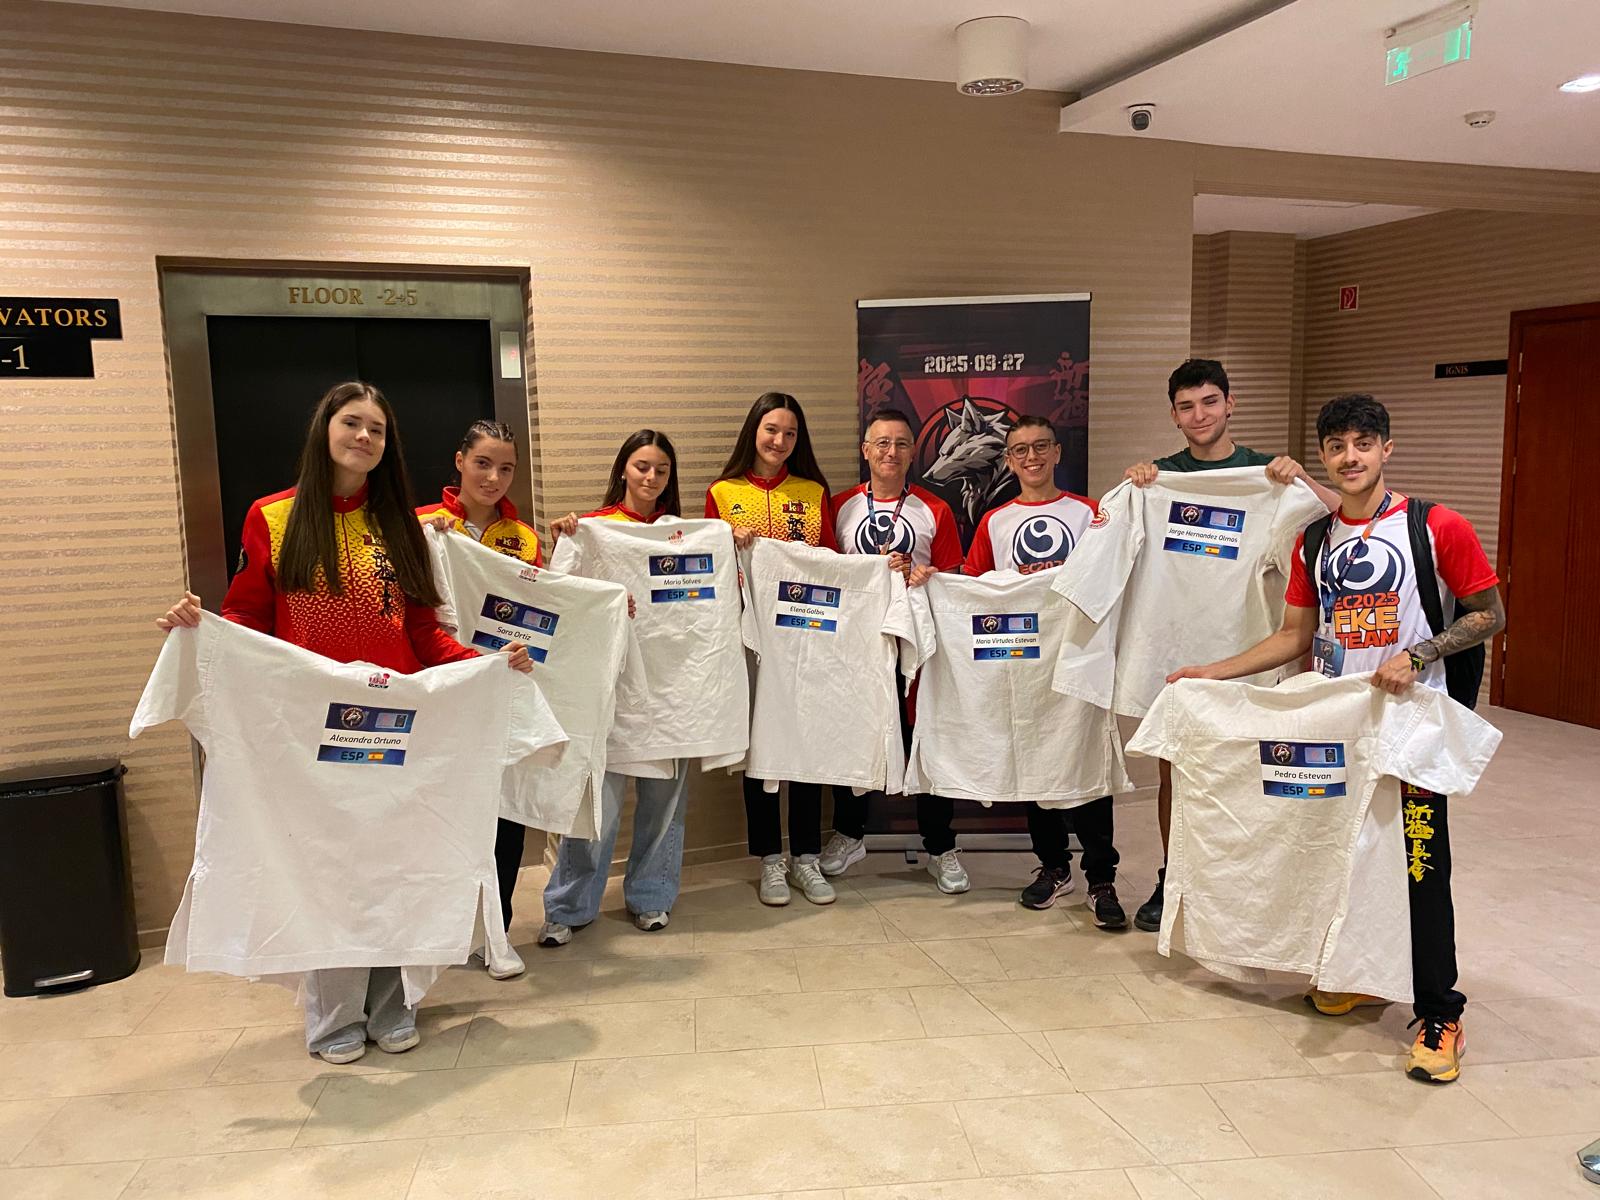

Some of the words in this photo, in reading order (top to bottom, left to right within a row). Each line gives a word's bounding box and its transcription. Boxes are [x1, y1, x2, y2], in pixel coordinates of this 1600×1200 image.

[288, 287, 364, 305] FLOOR
[1, 344, 30, 370] -1
[1445, 365, 1469, 376] IGNIS
[1168, 527, 1185, 537] Jorge
[1185, 531, 1218, 541] Hernandez
[1218, 534, 1238, 543] Olmos
[1182, 542, 1202, 553] ESP
[667, 591, 685, 600] ESP
[1334, 591, 1401, 610] EC2025
[790, 605, 806, 614] Elena
[791, 618, 806, 627] ESP
[1334, 606, 1400, 633] FKE
[497, 626, 513, 636] Sara
[514, 630, 532, 641] Ortiz
[491, 640, 507, 649] ES
[992, 637, 1014, 645] Virtudes
[1335, 629, 1399, 650] TEAM
[990, 649, 1008, 658] ESP
[329, 734, 372, 744] Alexandra
[340, 751, 365, 761] ESP
[1274, 770, 1297, 779] Pedro
[1298, 772, 1332, 780] Estevan
[1282, 785, 1304, 796] ESP
